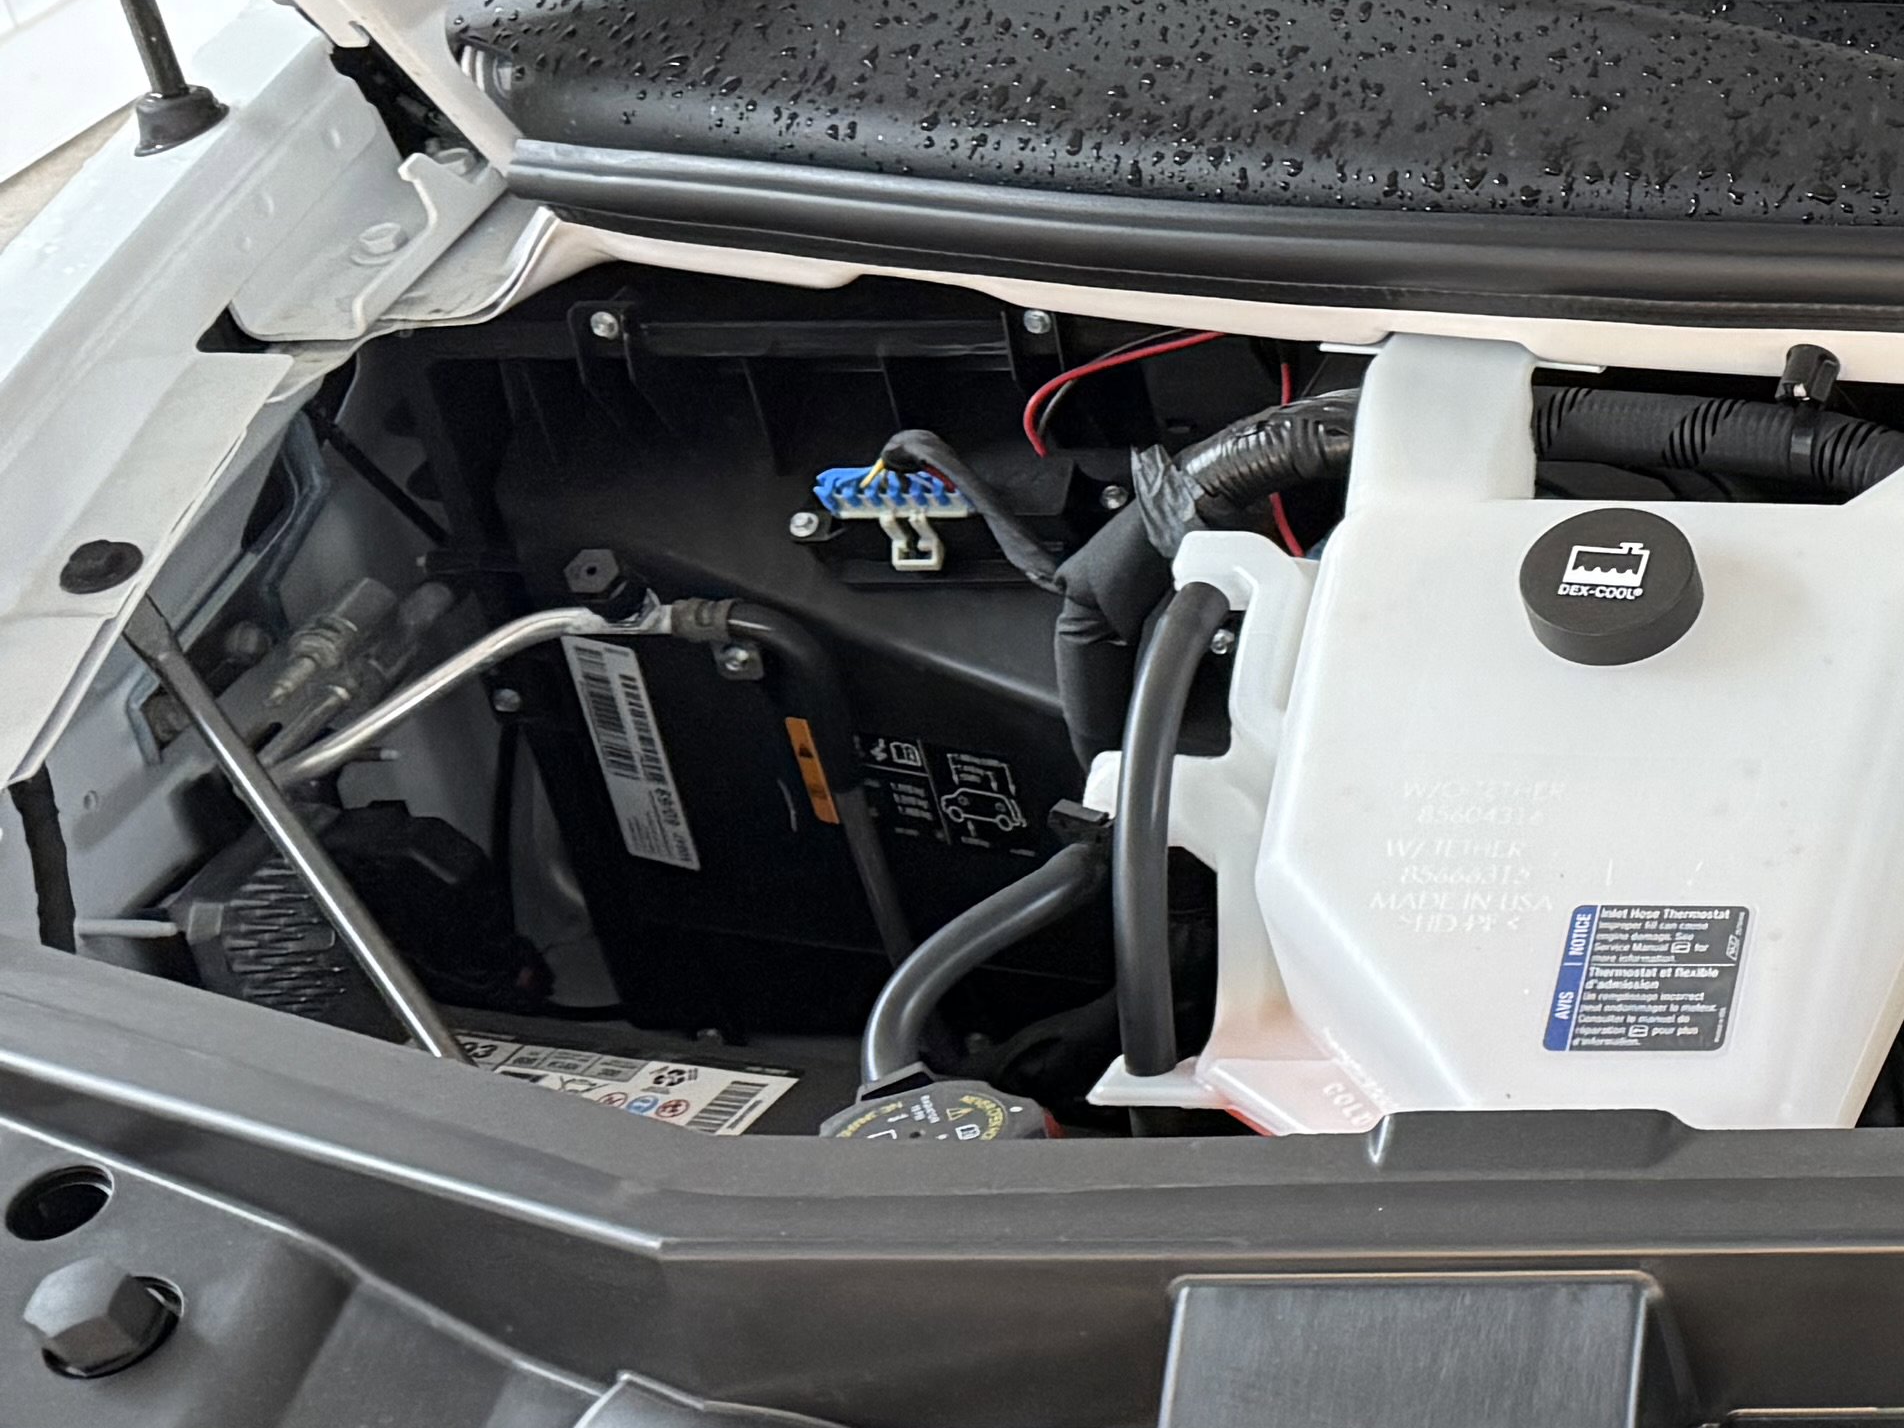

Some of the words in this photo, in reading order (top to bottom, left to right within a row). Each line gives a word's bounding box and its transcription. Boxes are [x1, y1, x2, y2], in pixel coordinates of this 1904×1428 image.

[1463, 890, 1493, 910] IN
[1663, 909, 1730, 920] Thermostat
[1569, 913, 1591, 956] NOTICE
[1589, 966, 1657, 978] Thermostat
[1554, 990, 1575, 1020] AVIS
[1322, 1082, 1373, 1126] COLD
